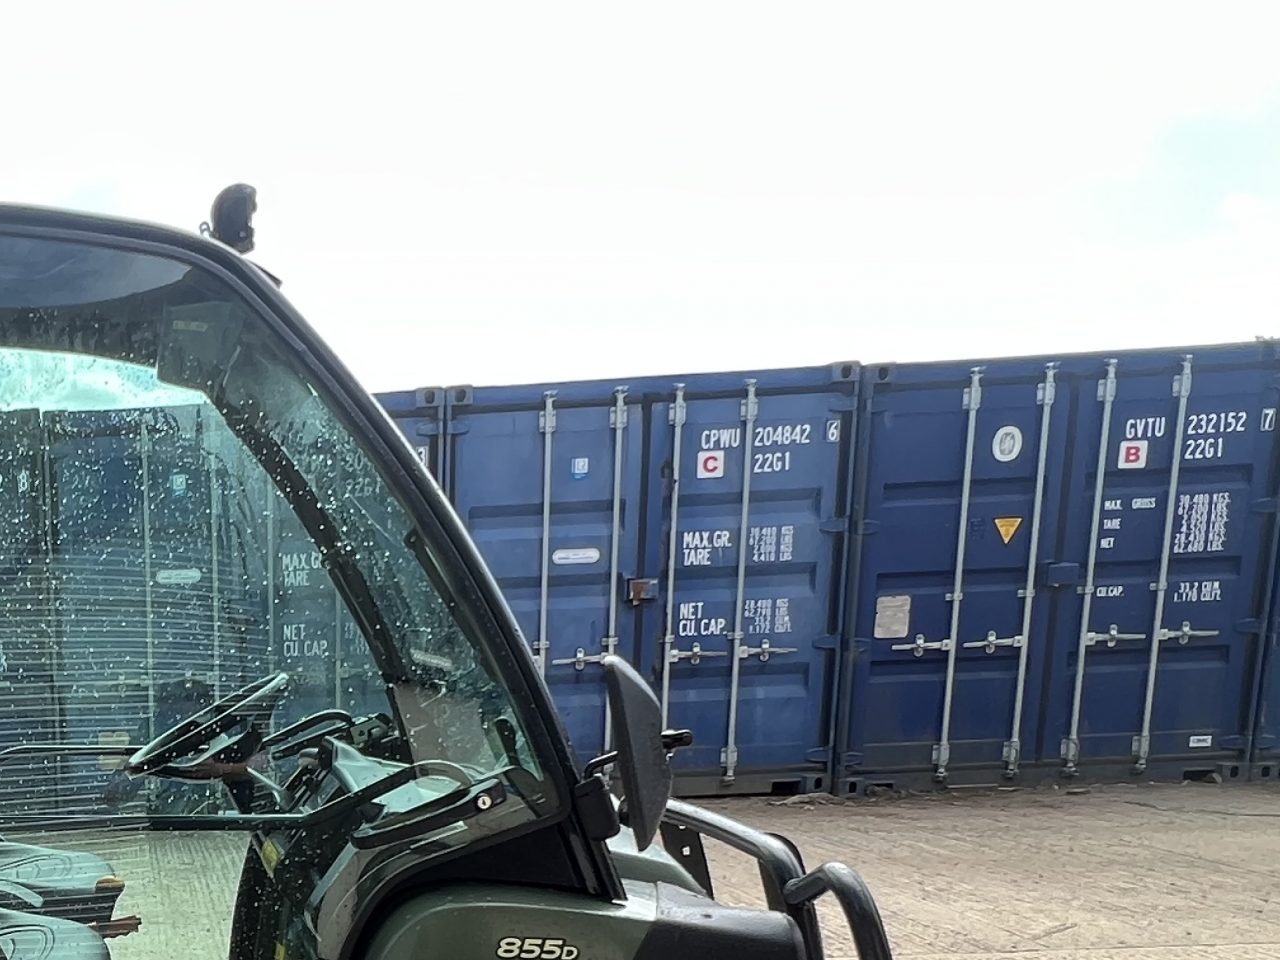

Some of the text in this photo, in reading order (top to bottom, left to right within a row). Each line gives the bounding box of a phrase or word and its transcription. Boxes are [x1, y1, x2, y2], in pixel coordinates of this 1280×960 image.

[1125, 416, 1166, 439] GVTU
[1187, 411, 1247, 435] 232152
[701, 422, 838, 449] CPWU 204842 6
[1124, 446, 1140, 463] B
[1184, 438, 1224, 459] 22G1
[703, 456, 718, 473] C
[753, 451, 790, 473] 22G1
[683, 548, 712, 566] TARE
[680, 602, 704, 620] NET
[283, 624, 306, 641] NET
[679, 618, 728, 636] CU. CAP.
